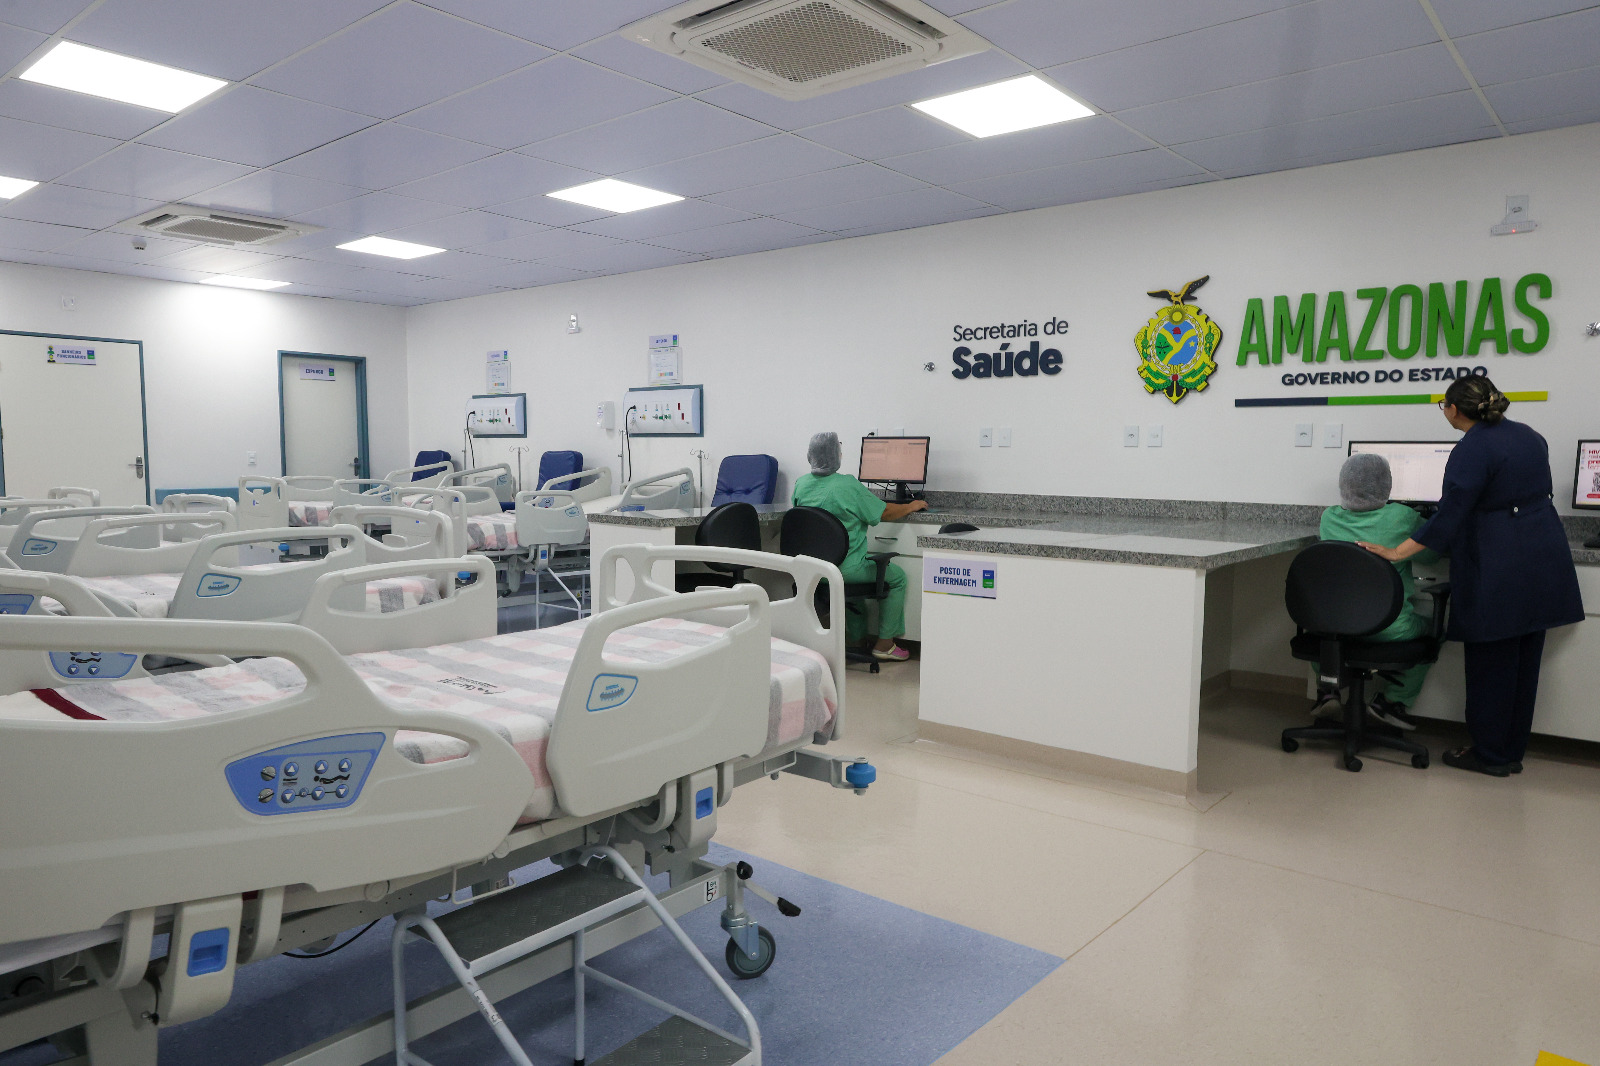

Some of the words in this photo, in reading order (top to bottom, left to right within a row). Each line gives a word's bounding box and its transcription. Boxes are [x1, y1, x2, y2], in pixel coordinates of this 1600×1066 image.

[952, 319, 1038, 342] Secretaria
[1043, 316, 1069, 336] de
[1235, 272, 1552, 367] AMAZONAS
[951, 340, 1063, 380] Saúde
[1281, 370, 1370, 386] GOVERNO
[1374, 369, 1404, 383] DO
[1408, 365, 1488, 382] ESTADO
[933, 576, 977, 587] ENFERMAGEM
[939, 567, 961, 576] POSTO
[962, 568, 971, 577] DE
